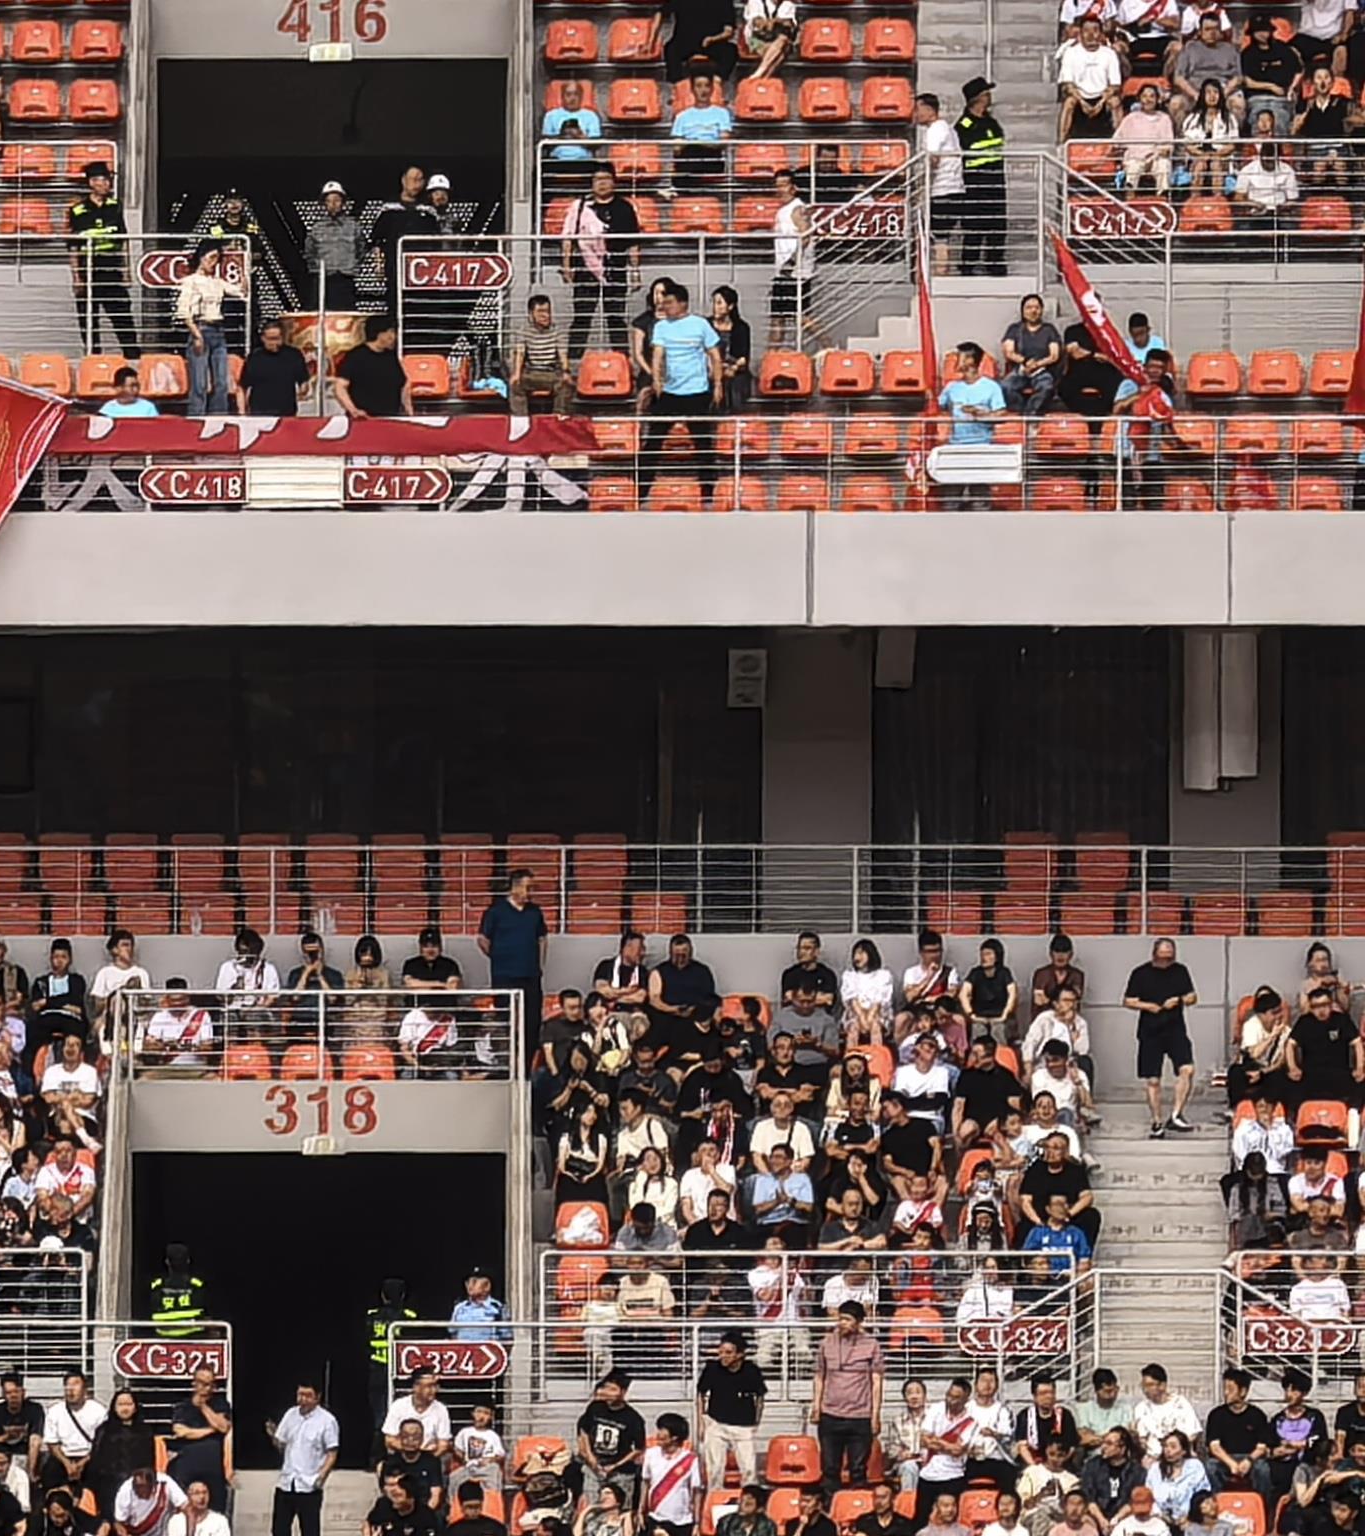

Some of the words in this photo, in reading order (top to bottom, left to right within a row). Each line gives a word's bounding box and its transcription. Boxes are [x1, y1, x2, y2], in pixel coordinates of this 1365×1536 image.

[277, 0, 387, 43] 416
[167, 256, 241, 284] C18
[408, 257, 481, 284] C417
[169, 470, 243, 498] C418
[347, 470, 421, 498] C417
[264, 1085, 379, 1136] 318
[989, 1322, 1065, 1350] C324
[1248, 1322, 1315, 1350] C32
[399, 1345, 475, 1373] C324
